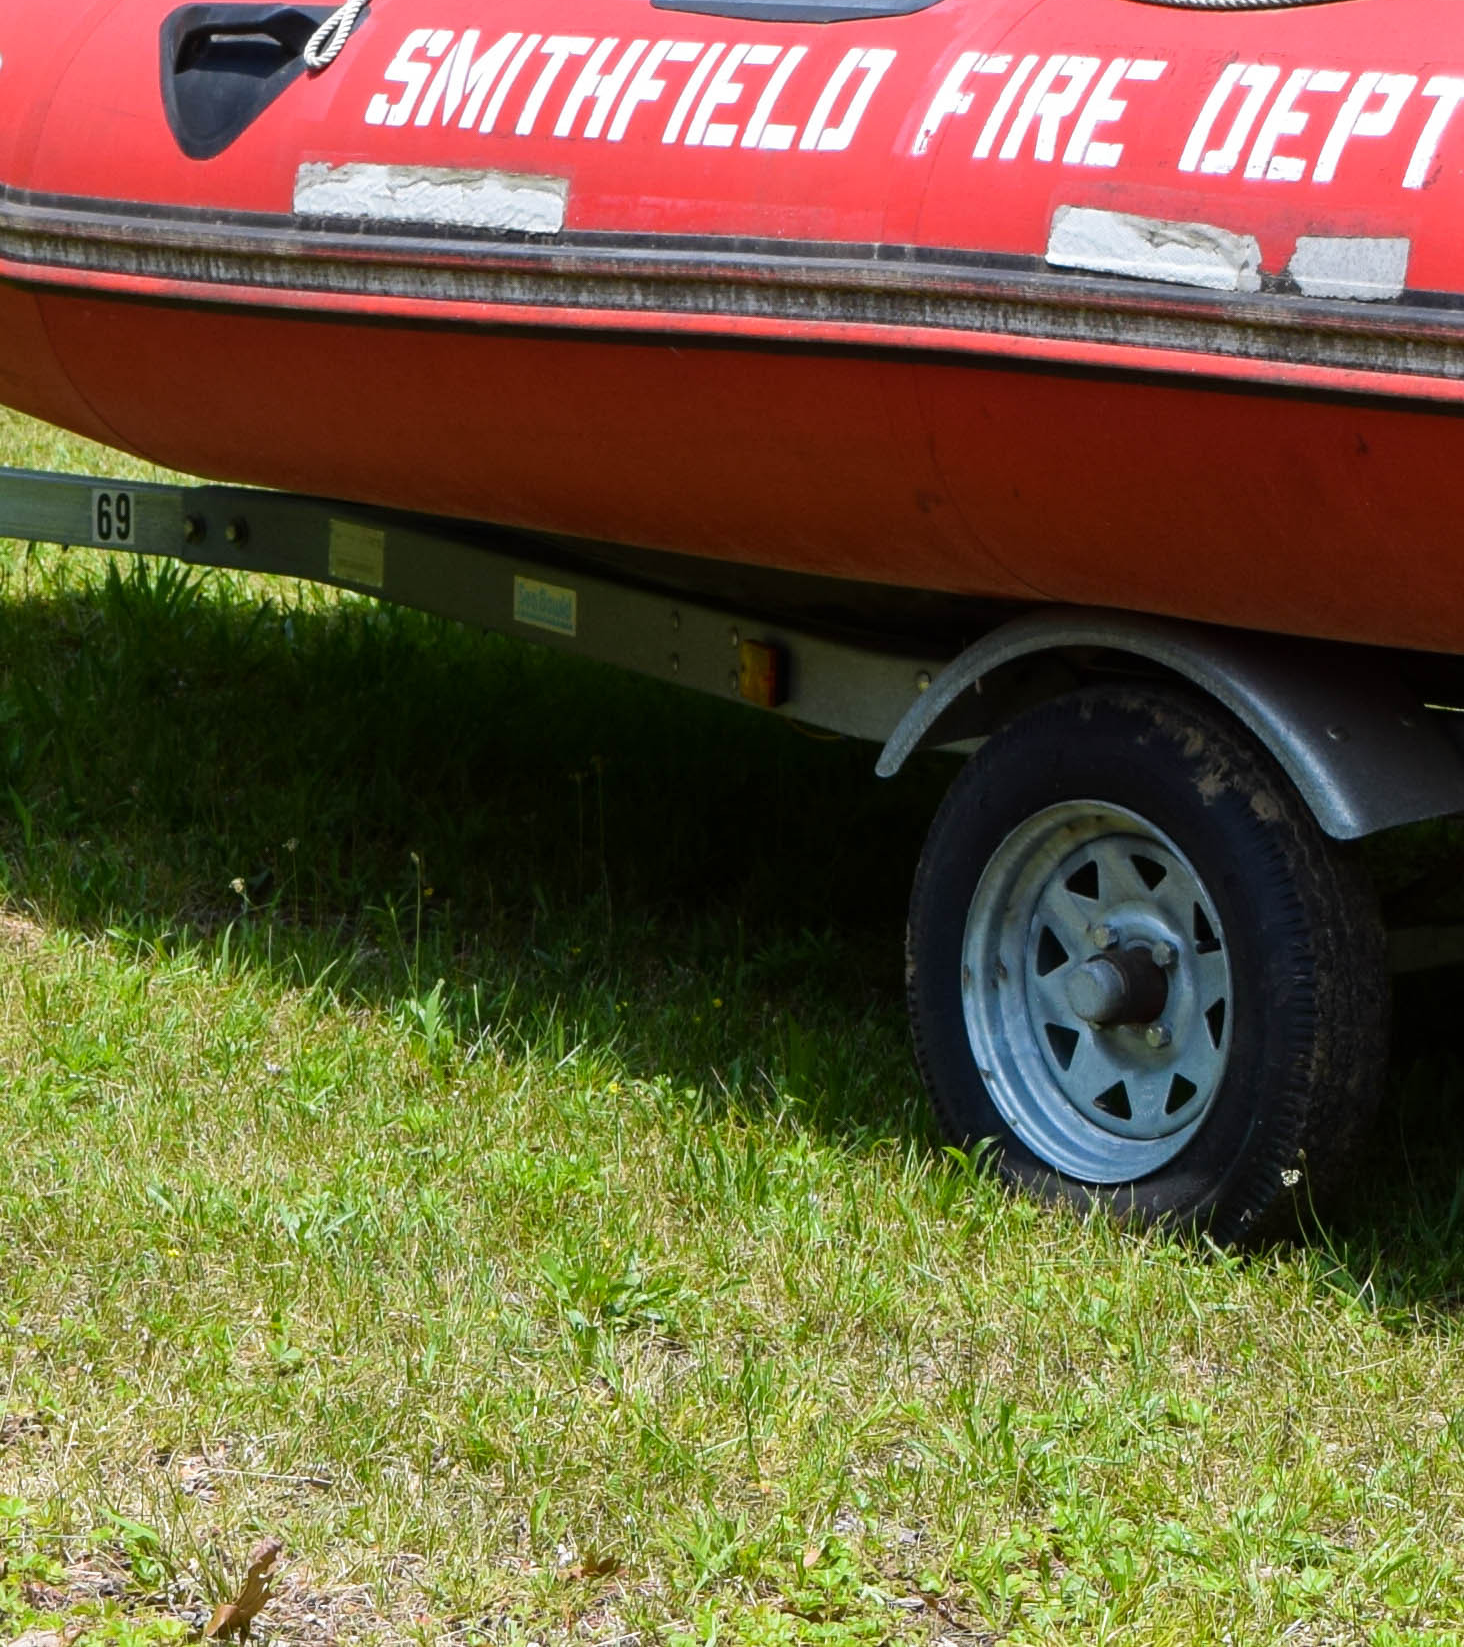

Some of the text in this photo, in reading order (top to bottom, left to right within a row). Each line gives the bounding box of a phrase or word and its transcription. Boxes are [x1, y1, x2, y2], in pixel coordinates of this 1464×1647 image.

[365, 29, 897, 151] SMITHFIELD
[912, 50, 1168, 168] FIRE
[97, 493, 131, 541] 69
